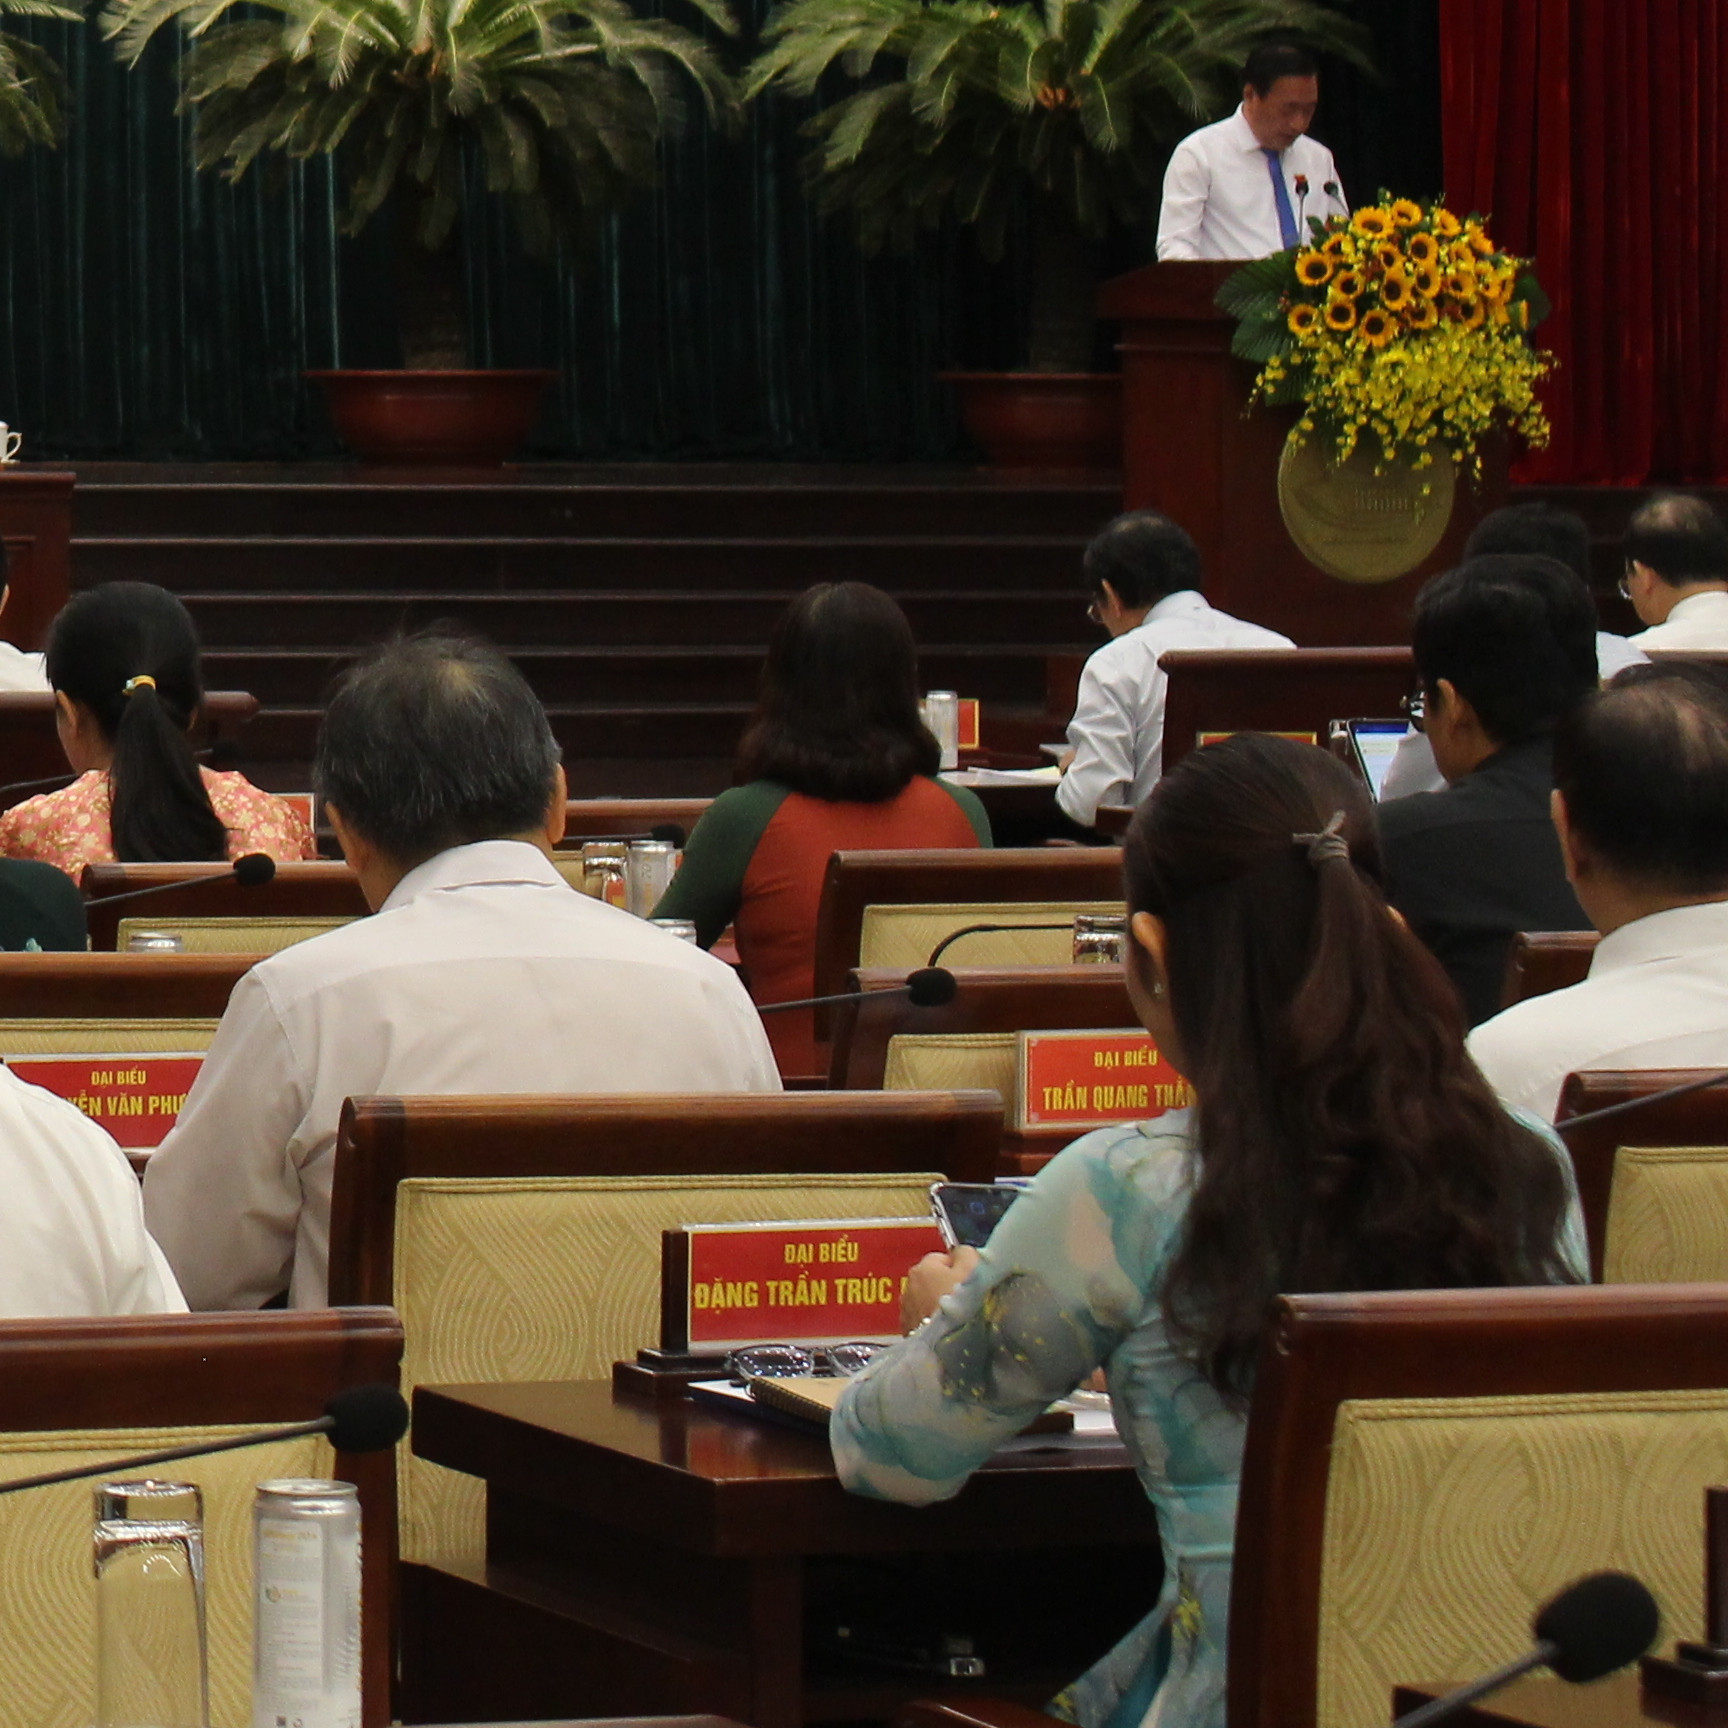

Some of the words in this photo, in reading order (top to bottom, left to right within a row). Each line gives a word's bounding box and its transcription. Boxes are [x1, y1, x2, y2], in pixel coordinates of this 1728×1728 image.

[1094, 1051, 1119, 1070] ĐẠI
[1124, 1045, 1158, 1067] BIỂU
[90, 1070, 113, 1088] ĐẠI
[117, 1065, 146, 1085] BIỂU
[107, 1092, 143, 1116] VĂN
[1093, 1084, 1148, 1112] QUANG
[784, 1243, 814, 1267] ĐẠI
[819, 1234, 859, 1263] BIỂU
[694, 1277, 759, 1315] ĐẶNG
[766, 1270, 827, 1307] TRẦN
[835, 1272, 893, 1305] TRÚC
